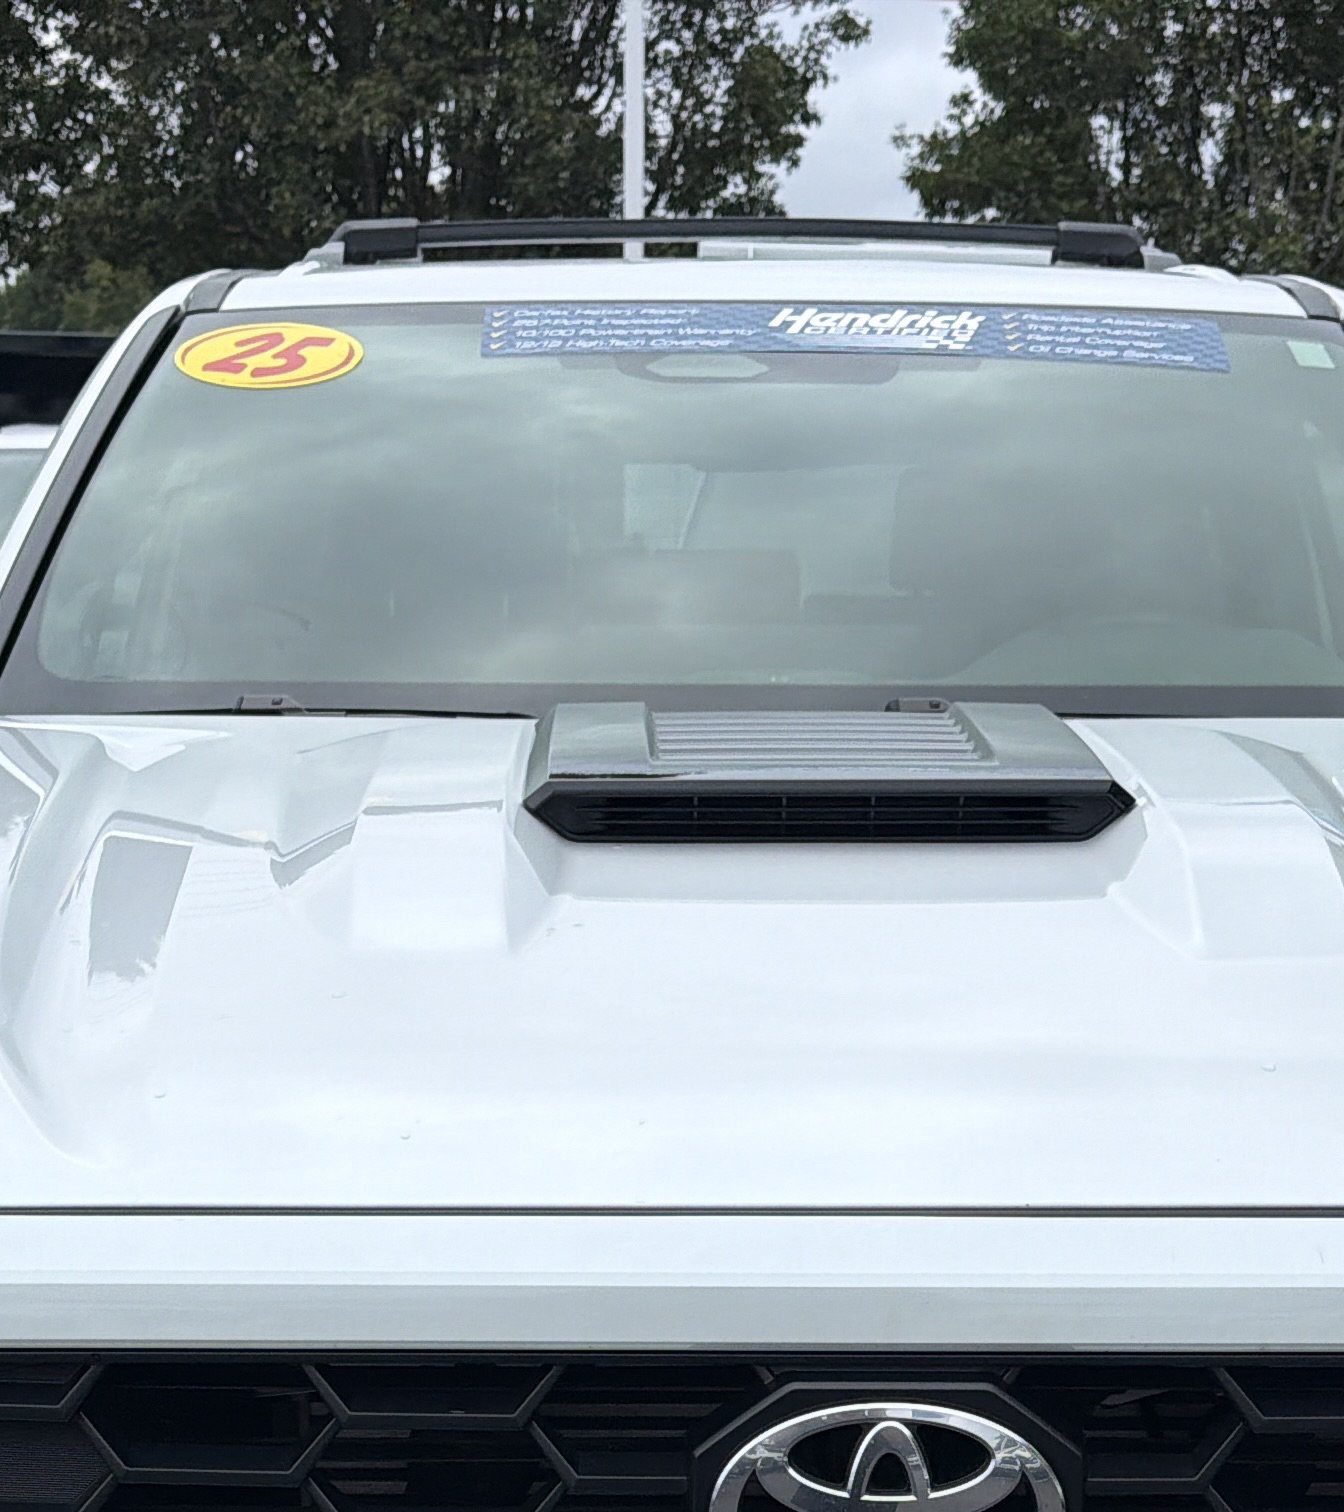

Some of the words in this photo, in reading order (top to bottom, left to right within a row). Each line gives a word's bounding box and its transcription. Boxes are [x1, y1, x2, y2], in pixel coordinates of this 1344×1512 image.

[513, 308, 569, 318] Carfax
[574, 308, 636, 317] History
[639, 308, 700, 316] Report
[768, 307, 986, 334] Hendrick
[1021, 313, 1097, 324] Roadside
[1101, 317, 1193, 330] Assistance
[515, 328, 576, 338] 10/100
[579, 328, 672, 337] Powertrain
[677, 327, 758, 337] Warranty
[803, 326, 975, 337] CERTIFIED
[1027, 323, 1056, 333] Trip
[1059, 324, 1160, 337] Interruption
[514, 339, 564, 349] 12/12
[649, 338, 735, 347] Coverage
[1027, 333, 1082, 343] Rental
[1085, 336, 1168, 349] Coverage
[201, 332, 336, 378] 25
[1028, 344, 1051, 353] Oil
[1054, 346, 1119, 358] Change
[1122, 350, 1195, 362] Services
